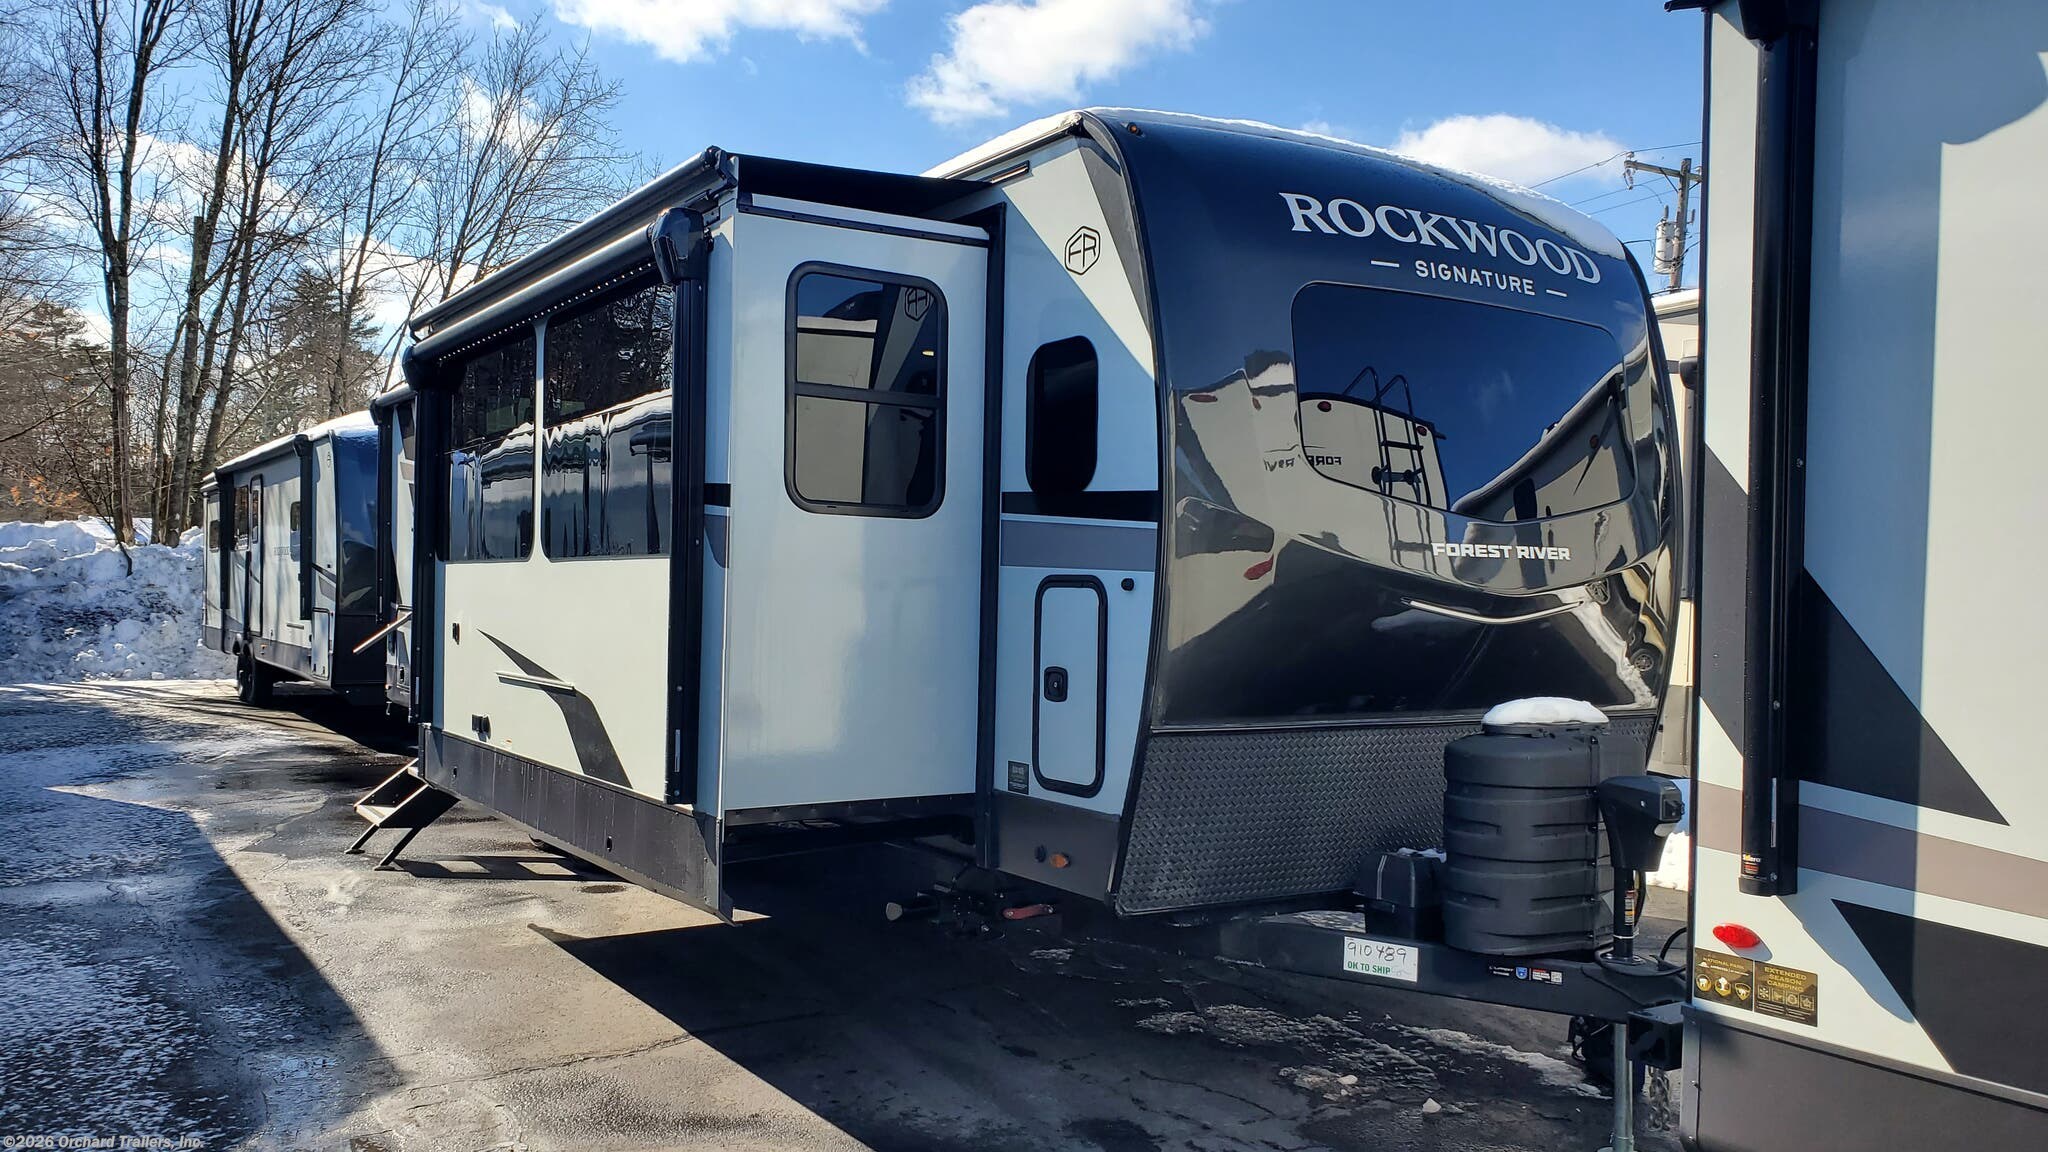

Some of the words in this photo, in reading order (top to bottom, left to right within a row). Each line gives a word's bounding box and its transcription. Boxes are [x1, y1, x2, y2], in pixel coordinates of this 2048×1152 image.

[1279, 192, 1601, 284] ROCKWOOD
[1415, 259, 1535, 296] SIGNATURE
[1431, 542, 1513, 559] FOREST
[1515, 545, 1571, 561] RIVER
[1347, 960, 1359, 970] OK
[1360, 962, 1370, 972] TO
[1372, 964, 1391, 975] SHIP
[1764, 966, 1807, 981] EXTENDED
[1766, 979, 1804, 993] CAMPING
[1769, 973, 1802, 986] SEASON
